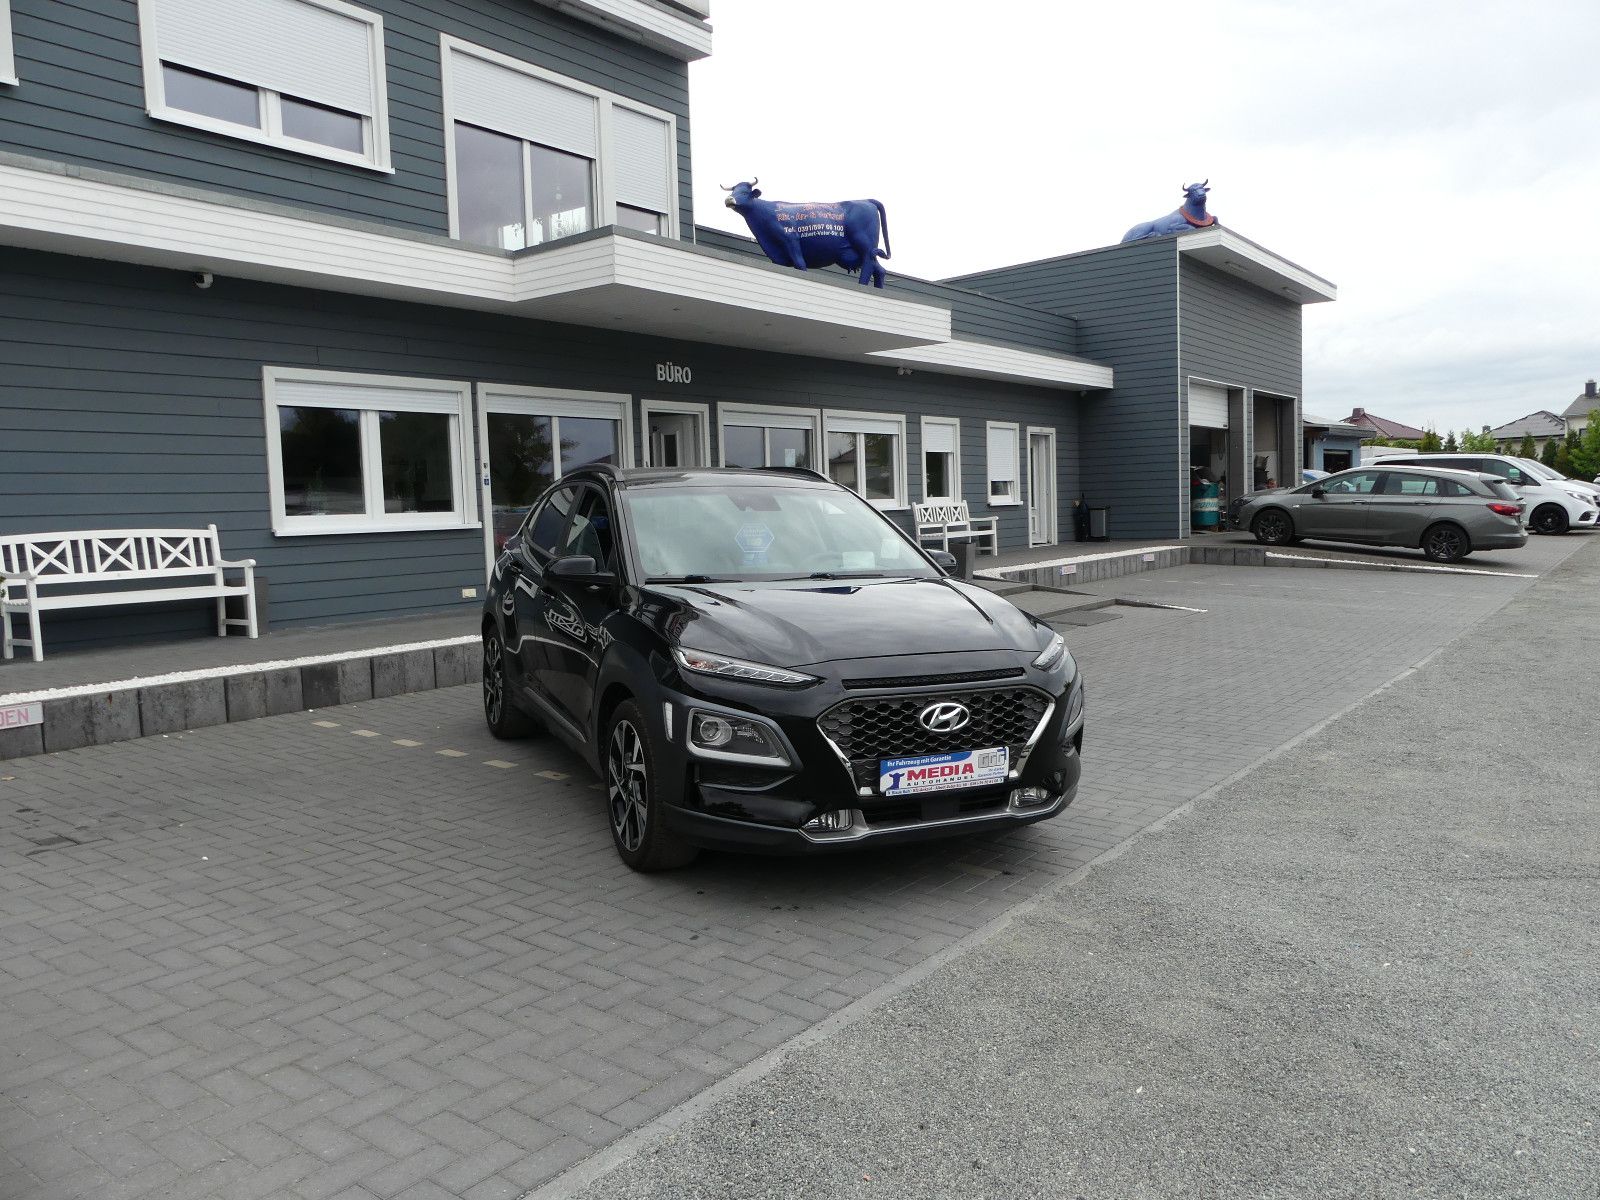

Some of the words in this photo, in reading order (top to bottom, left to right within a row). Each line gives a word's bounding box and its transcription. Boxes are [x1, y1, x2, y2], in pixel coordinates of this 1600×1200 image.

[656, 361, 692, 383] BÜRO
[930, 755, 952, 763] Garantie
[906, 763, 975, 781] MEDIA
[906, 774, 975, 787] AUTOHANDEL
